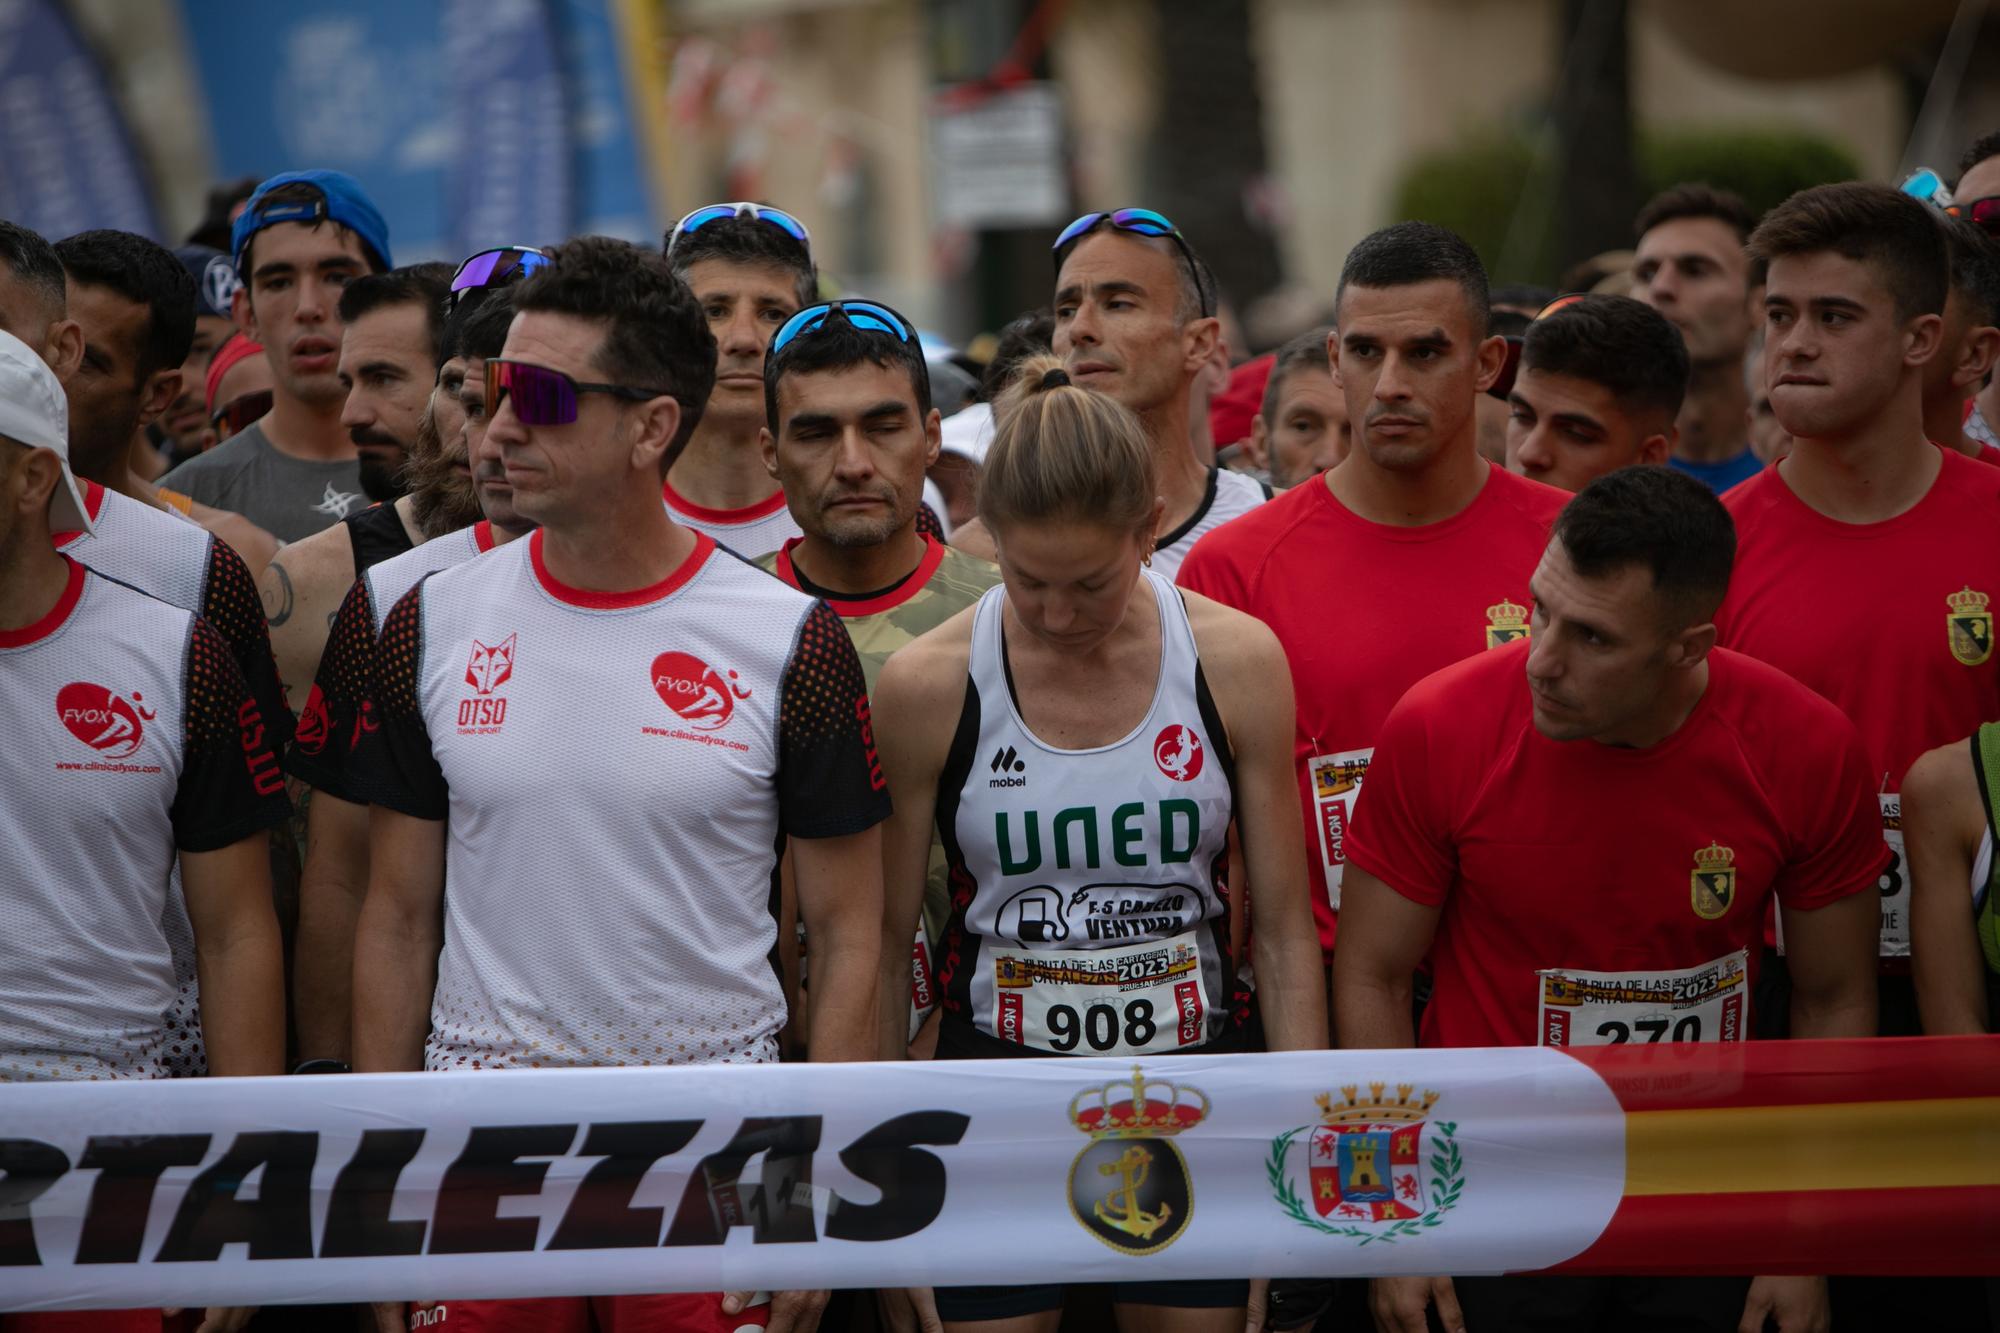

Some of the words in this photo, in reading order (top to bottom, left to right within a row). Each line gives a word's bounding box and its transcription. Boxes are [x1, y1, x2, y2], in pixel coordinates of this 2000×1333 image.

[656, 675, 704, 696] FYOX
[63, 708, 111, 724] FYOX
[457, 698, 507, 726] OTSO
[478, 726, 503, 735] SPORT
[641, 726, 750, 752] www.clinicafyox.com
[56, 761, 161, 774] www.clinicafyox.com
[989, 776, 1026, 788] mobel
[1883, 803, 1900, 815] AS
[995, 798, 1200, 877] UNED
[1085, 916, 1184, 941] VENTURA
[1038, 959, 1068, 972] RUTA
[1071, 960, 1087, 972] DE
[1090, 959, 1114, 972] LAS
[1117, 949, 1168, 966] CARTAGENA
[1024, 970, 1117, 985] FORTALEZAS
[1118, 958, 1169, 982] 2023
[1589, 979, 1622, 991] RUTA
[1626, 980, 1642, 991] DE
[1645, 979, 1671, 991] LAS
[1673, 975, 1719, 1000] 2023
[1574, 990, 1672, 1004] FORTALEZAS
[1003, 1008, 1016, 1042] AJON
[1046, 998, 1157, 1051] 908
[1182, 1002, 1197, 1040] CAJON
[1596, 1015, 1702, 1050] 270
[0, 1110, 971, 1266] RTALEZAS
